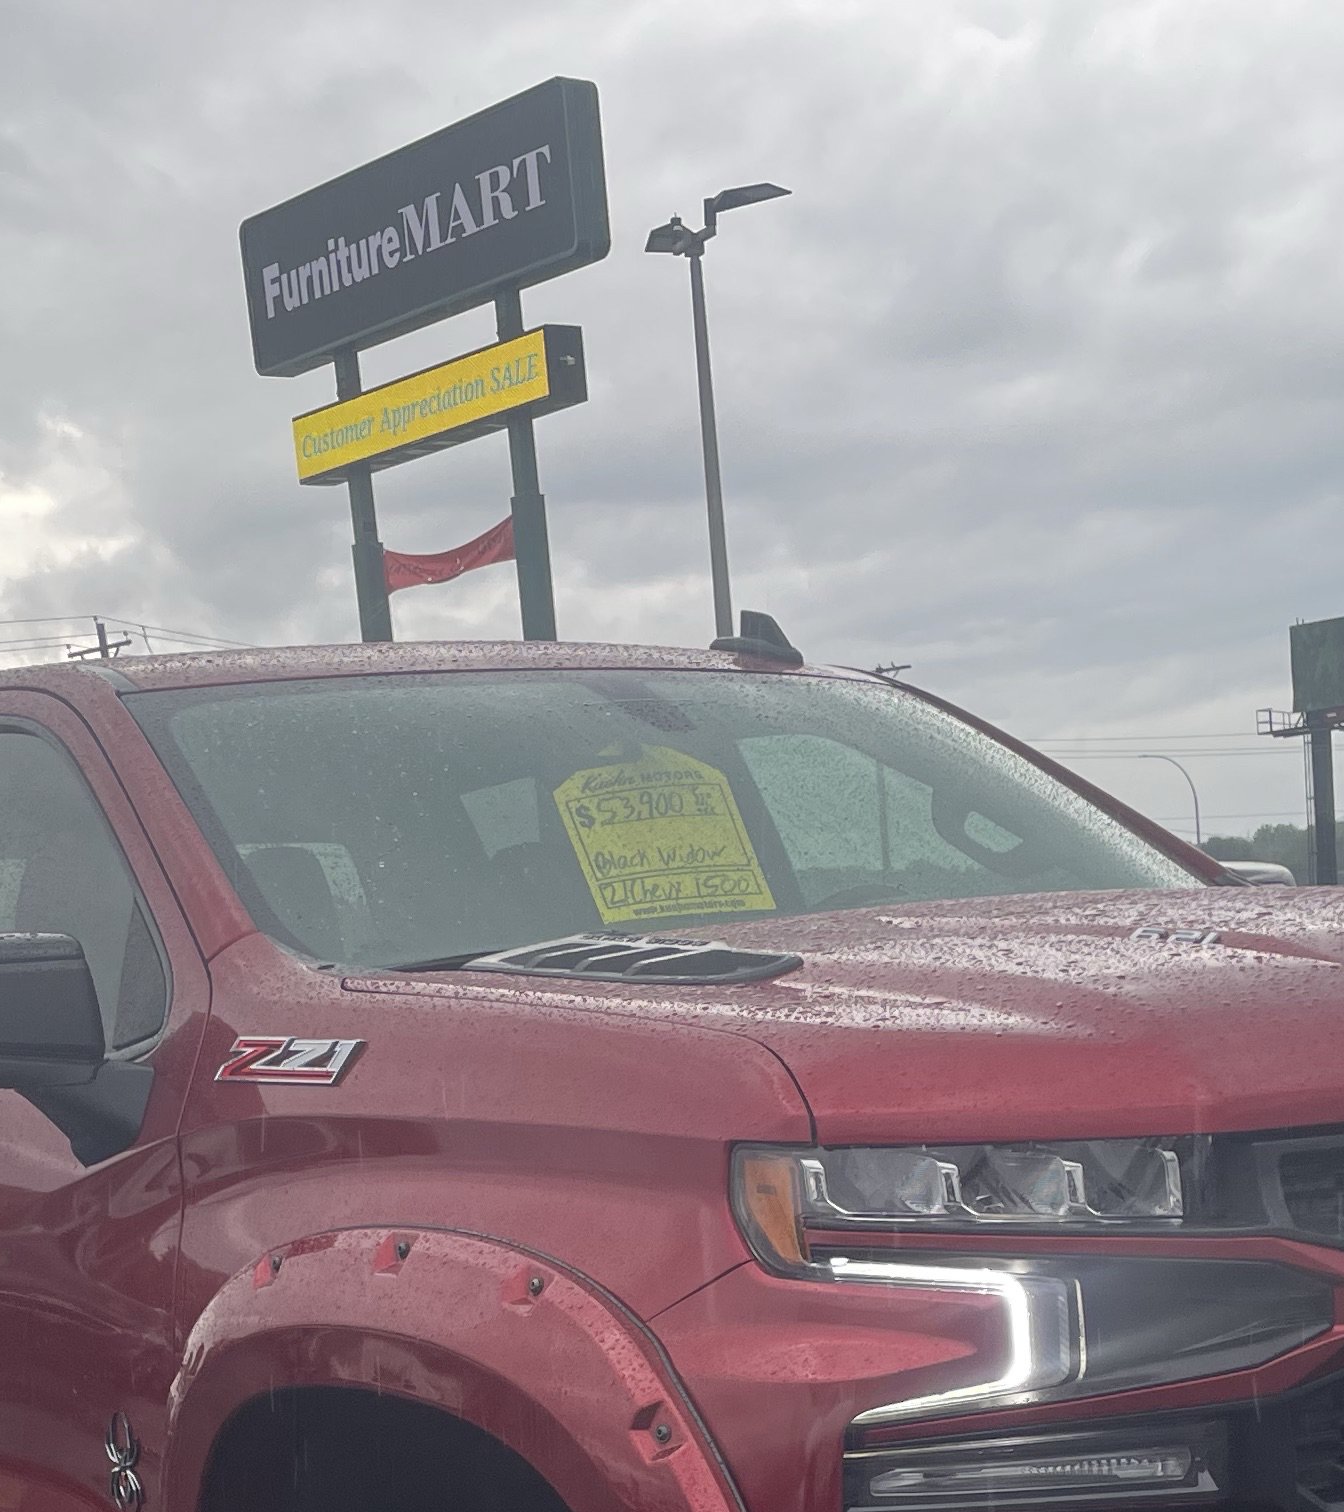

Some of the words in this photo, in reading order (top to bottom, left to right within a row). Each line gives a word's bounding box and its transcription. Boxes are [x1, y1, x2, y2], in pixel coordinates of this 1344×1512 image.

[262, 145, 551, 319] FurnitureMART
[302, 416, 374, 459] Customer
[380, 377, 485, 436] Appreciation
[490, 353, 538, 394] SALE
[640, 769, 705, 783] MOTORS
[695, 875, 750, 902] 1500
[214, 1036, 367, 1084] Z71
